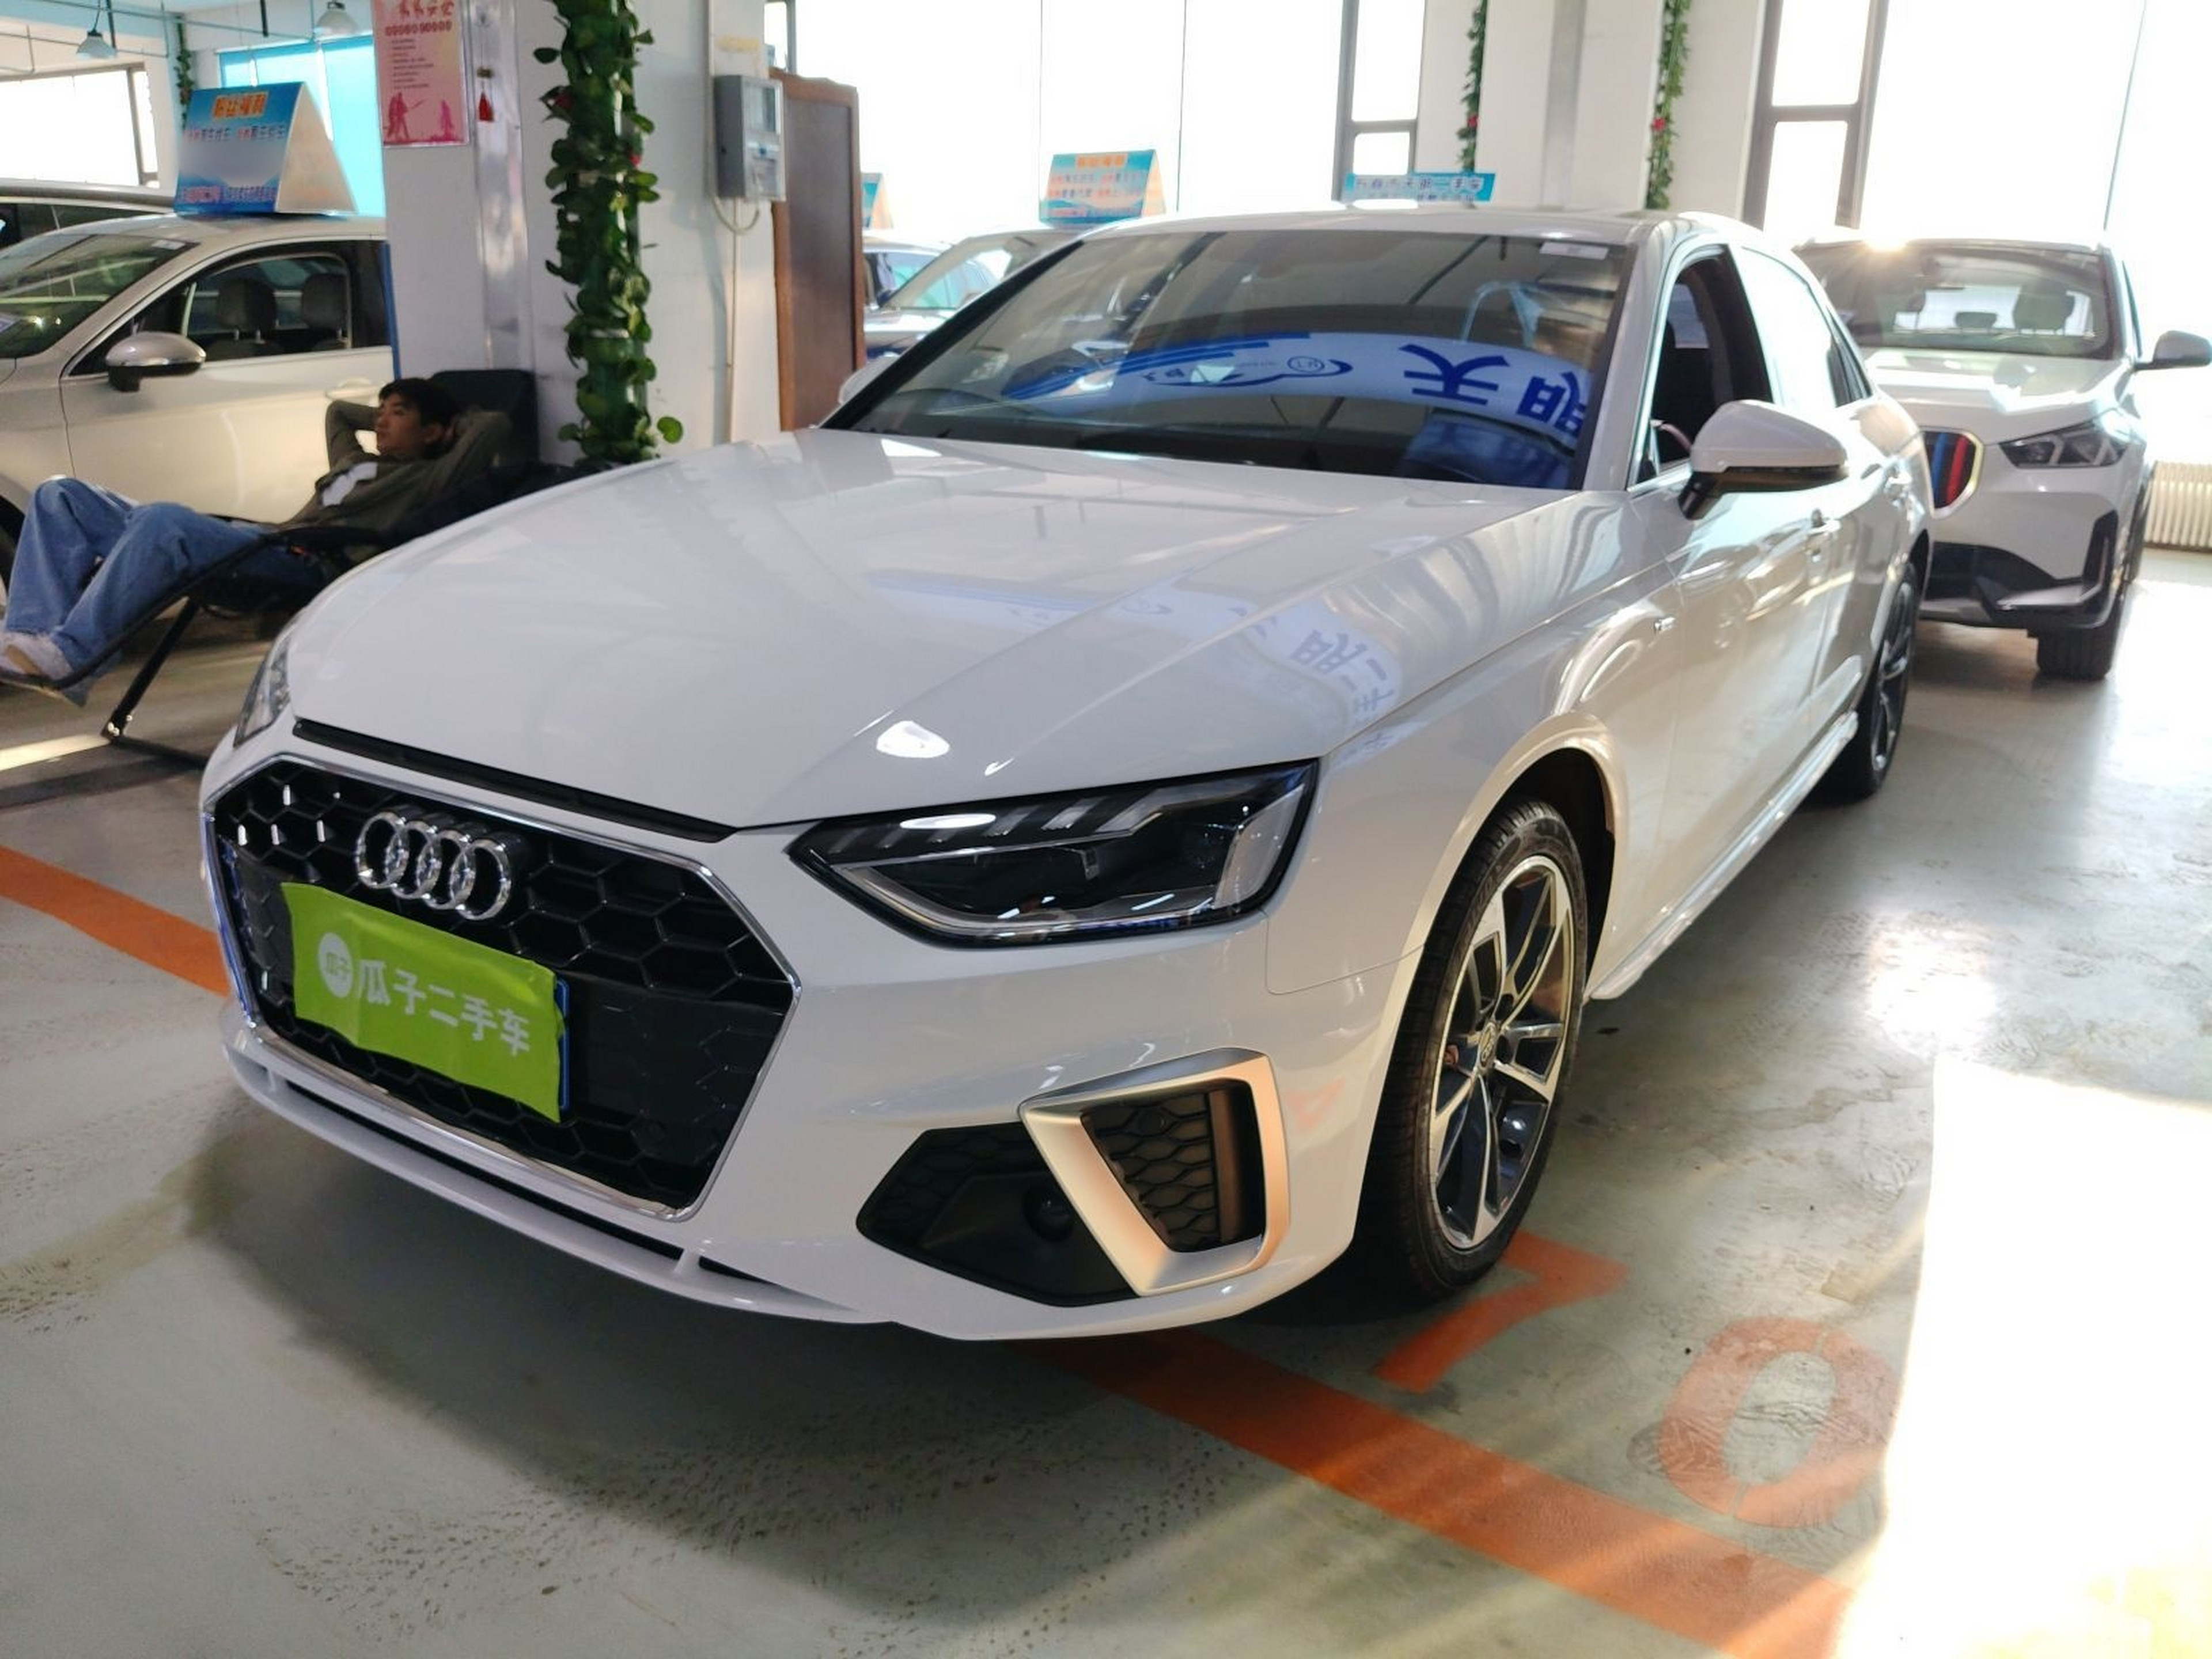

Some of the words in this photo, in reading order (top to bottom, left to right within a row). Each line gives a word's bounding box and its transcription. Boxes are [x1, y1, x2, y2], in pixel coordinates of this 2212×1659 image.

[358, 958, 531, 1058] 瓜子二手车
